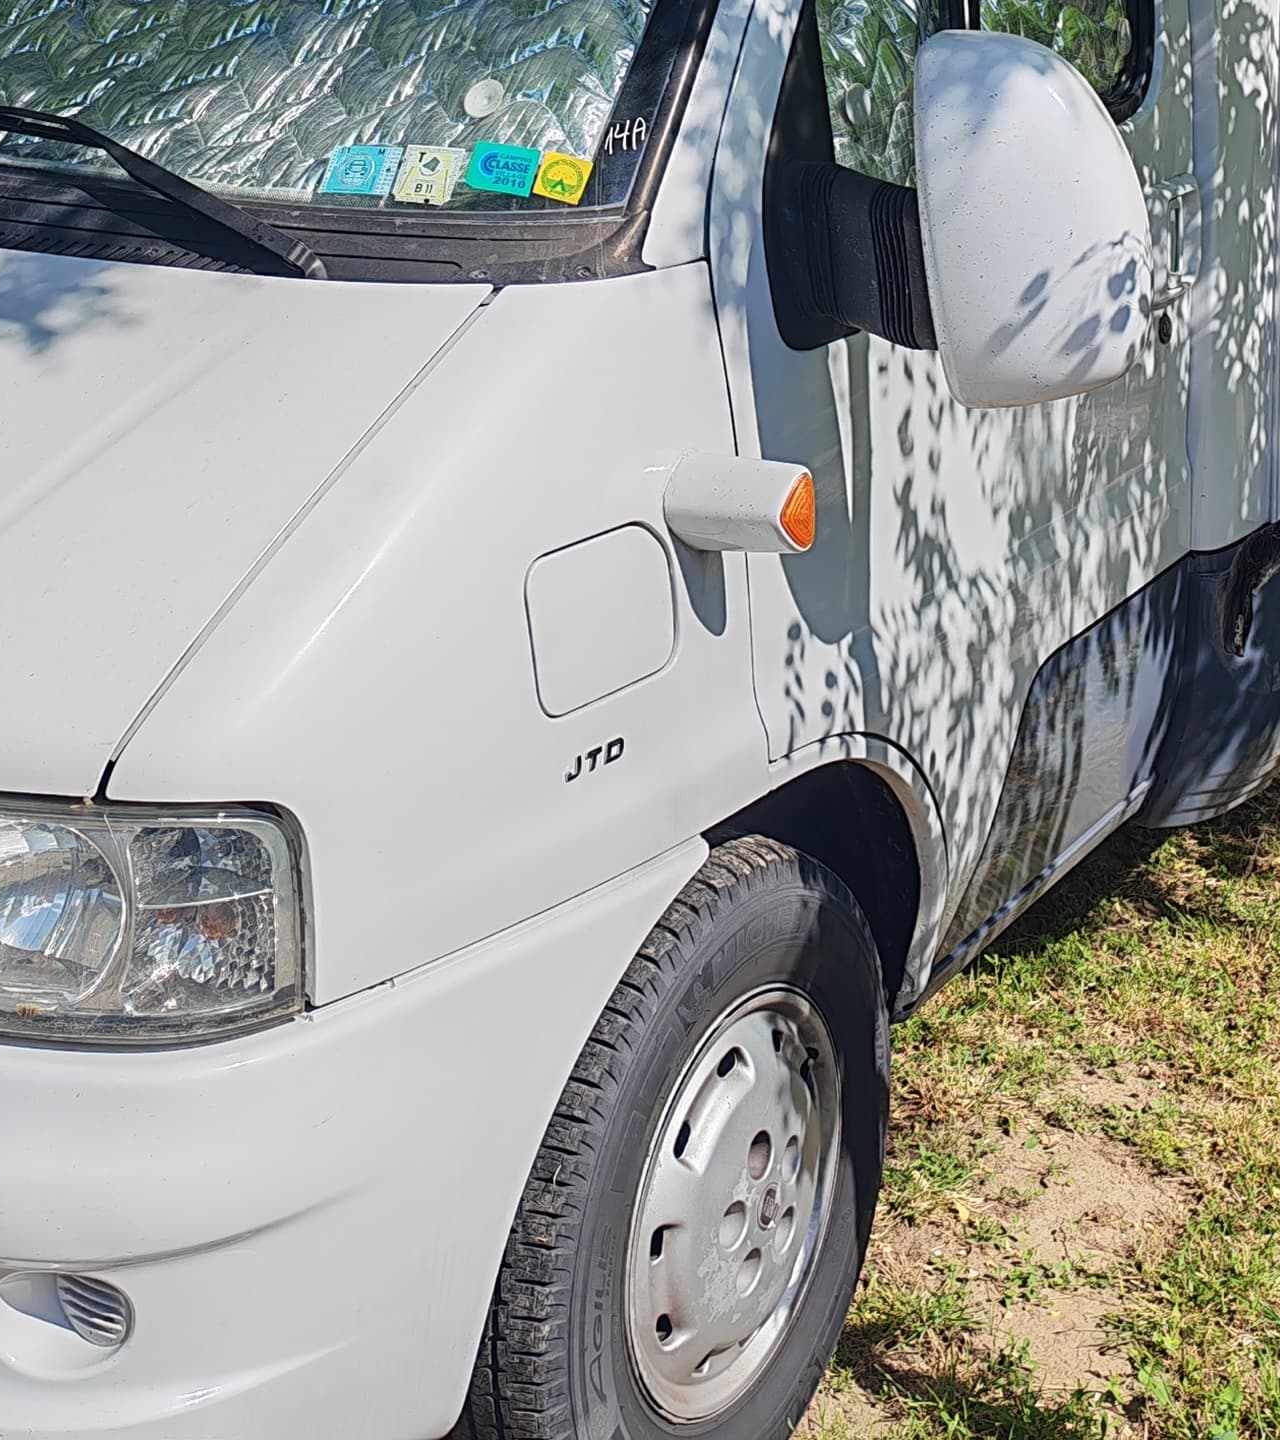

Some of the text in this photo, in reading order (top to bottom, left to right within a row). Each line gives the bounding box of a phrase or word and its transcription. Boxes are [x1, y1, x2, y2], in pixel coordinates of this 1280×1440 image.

[488, 159, 532, 174] CLASSE
[492, 176, 526, 189] 2010
[565, 737, 625, 783] JTD
